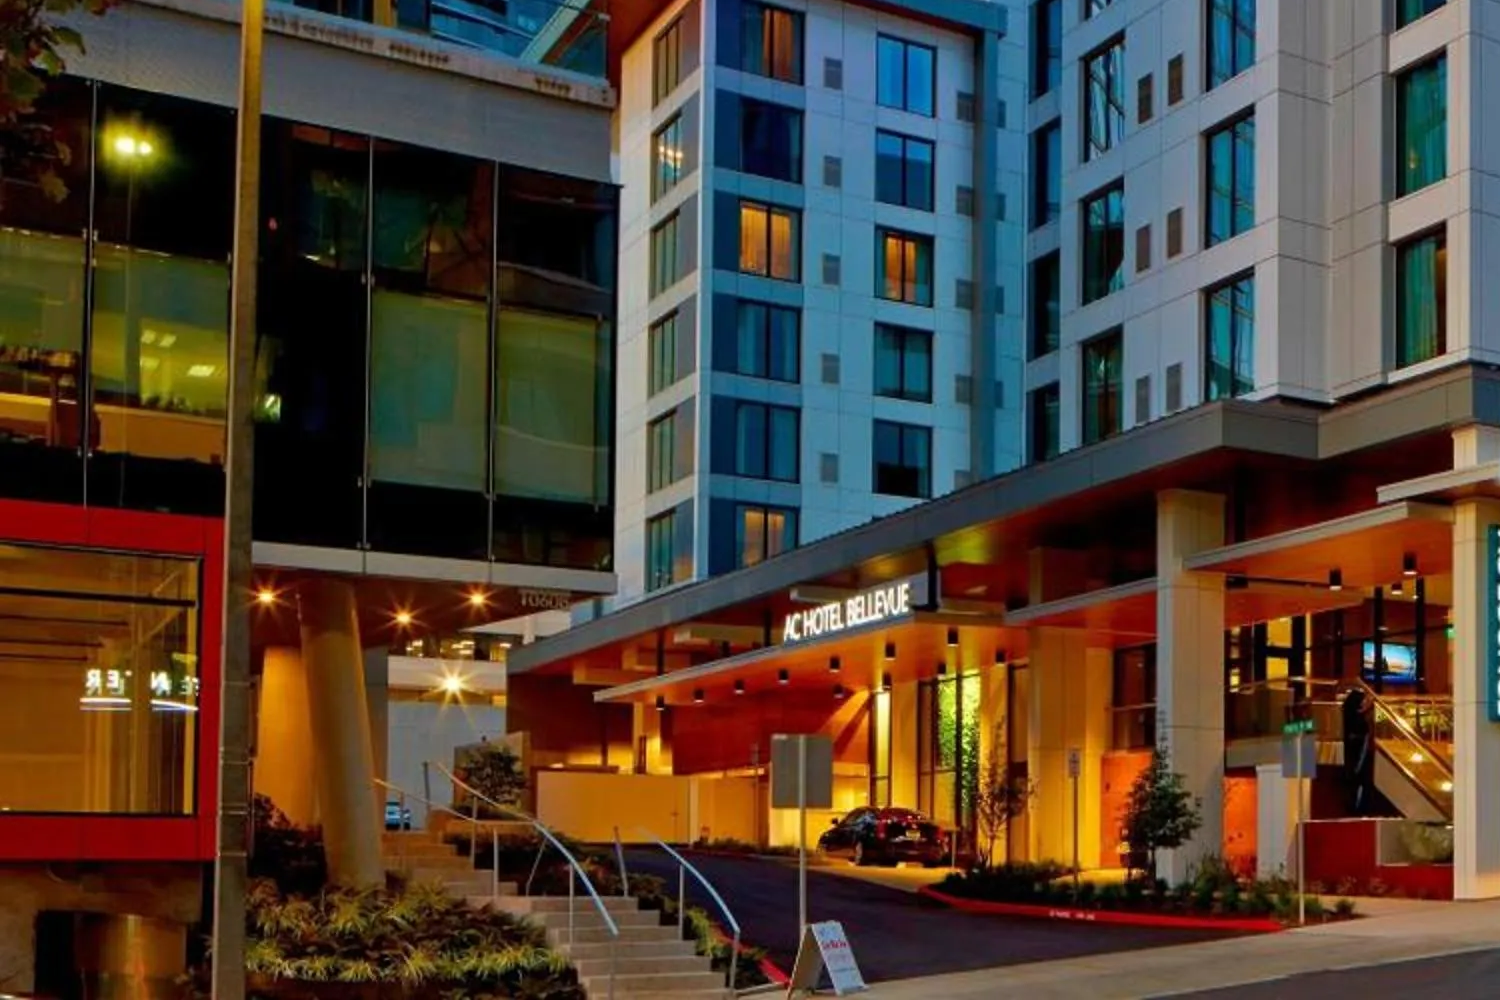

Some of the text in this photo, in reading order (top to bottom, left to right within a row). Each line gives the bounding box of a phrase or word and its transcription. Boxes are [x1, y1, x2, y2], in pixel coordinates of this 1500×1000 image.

[783, 582, 909, 642] AC HOTEL BELLEVUE
